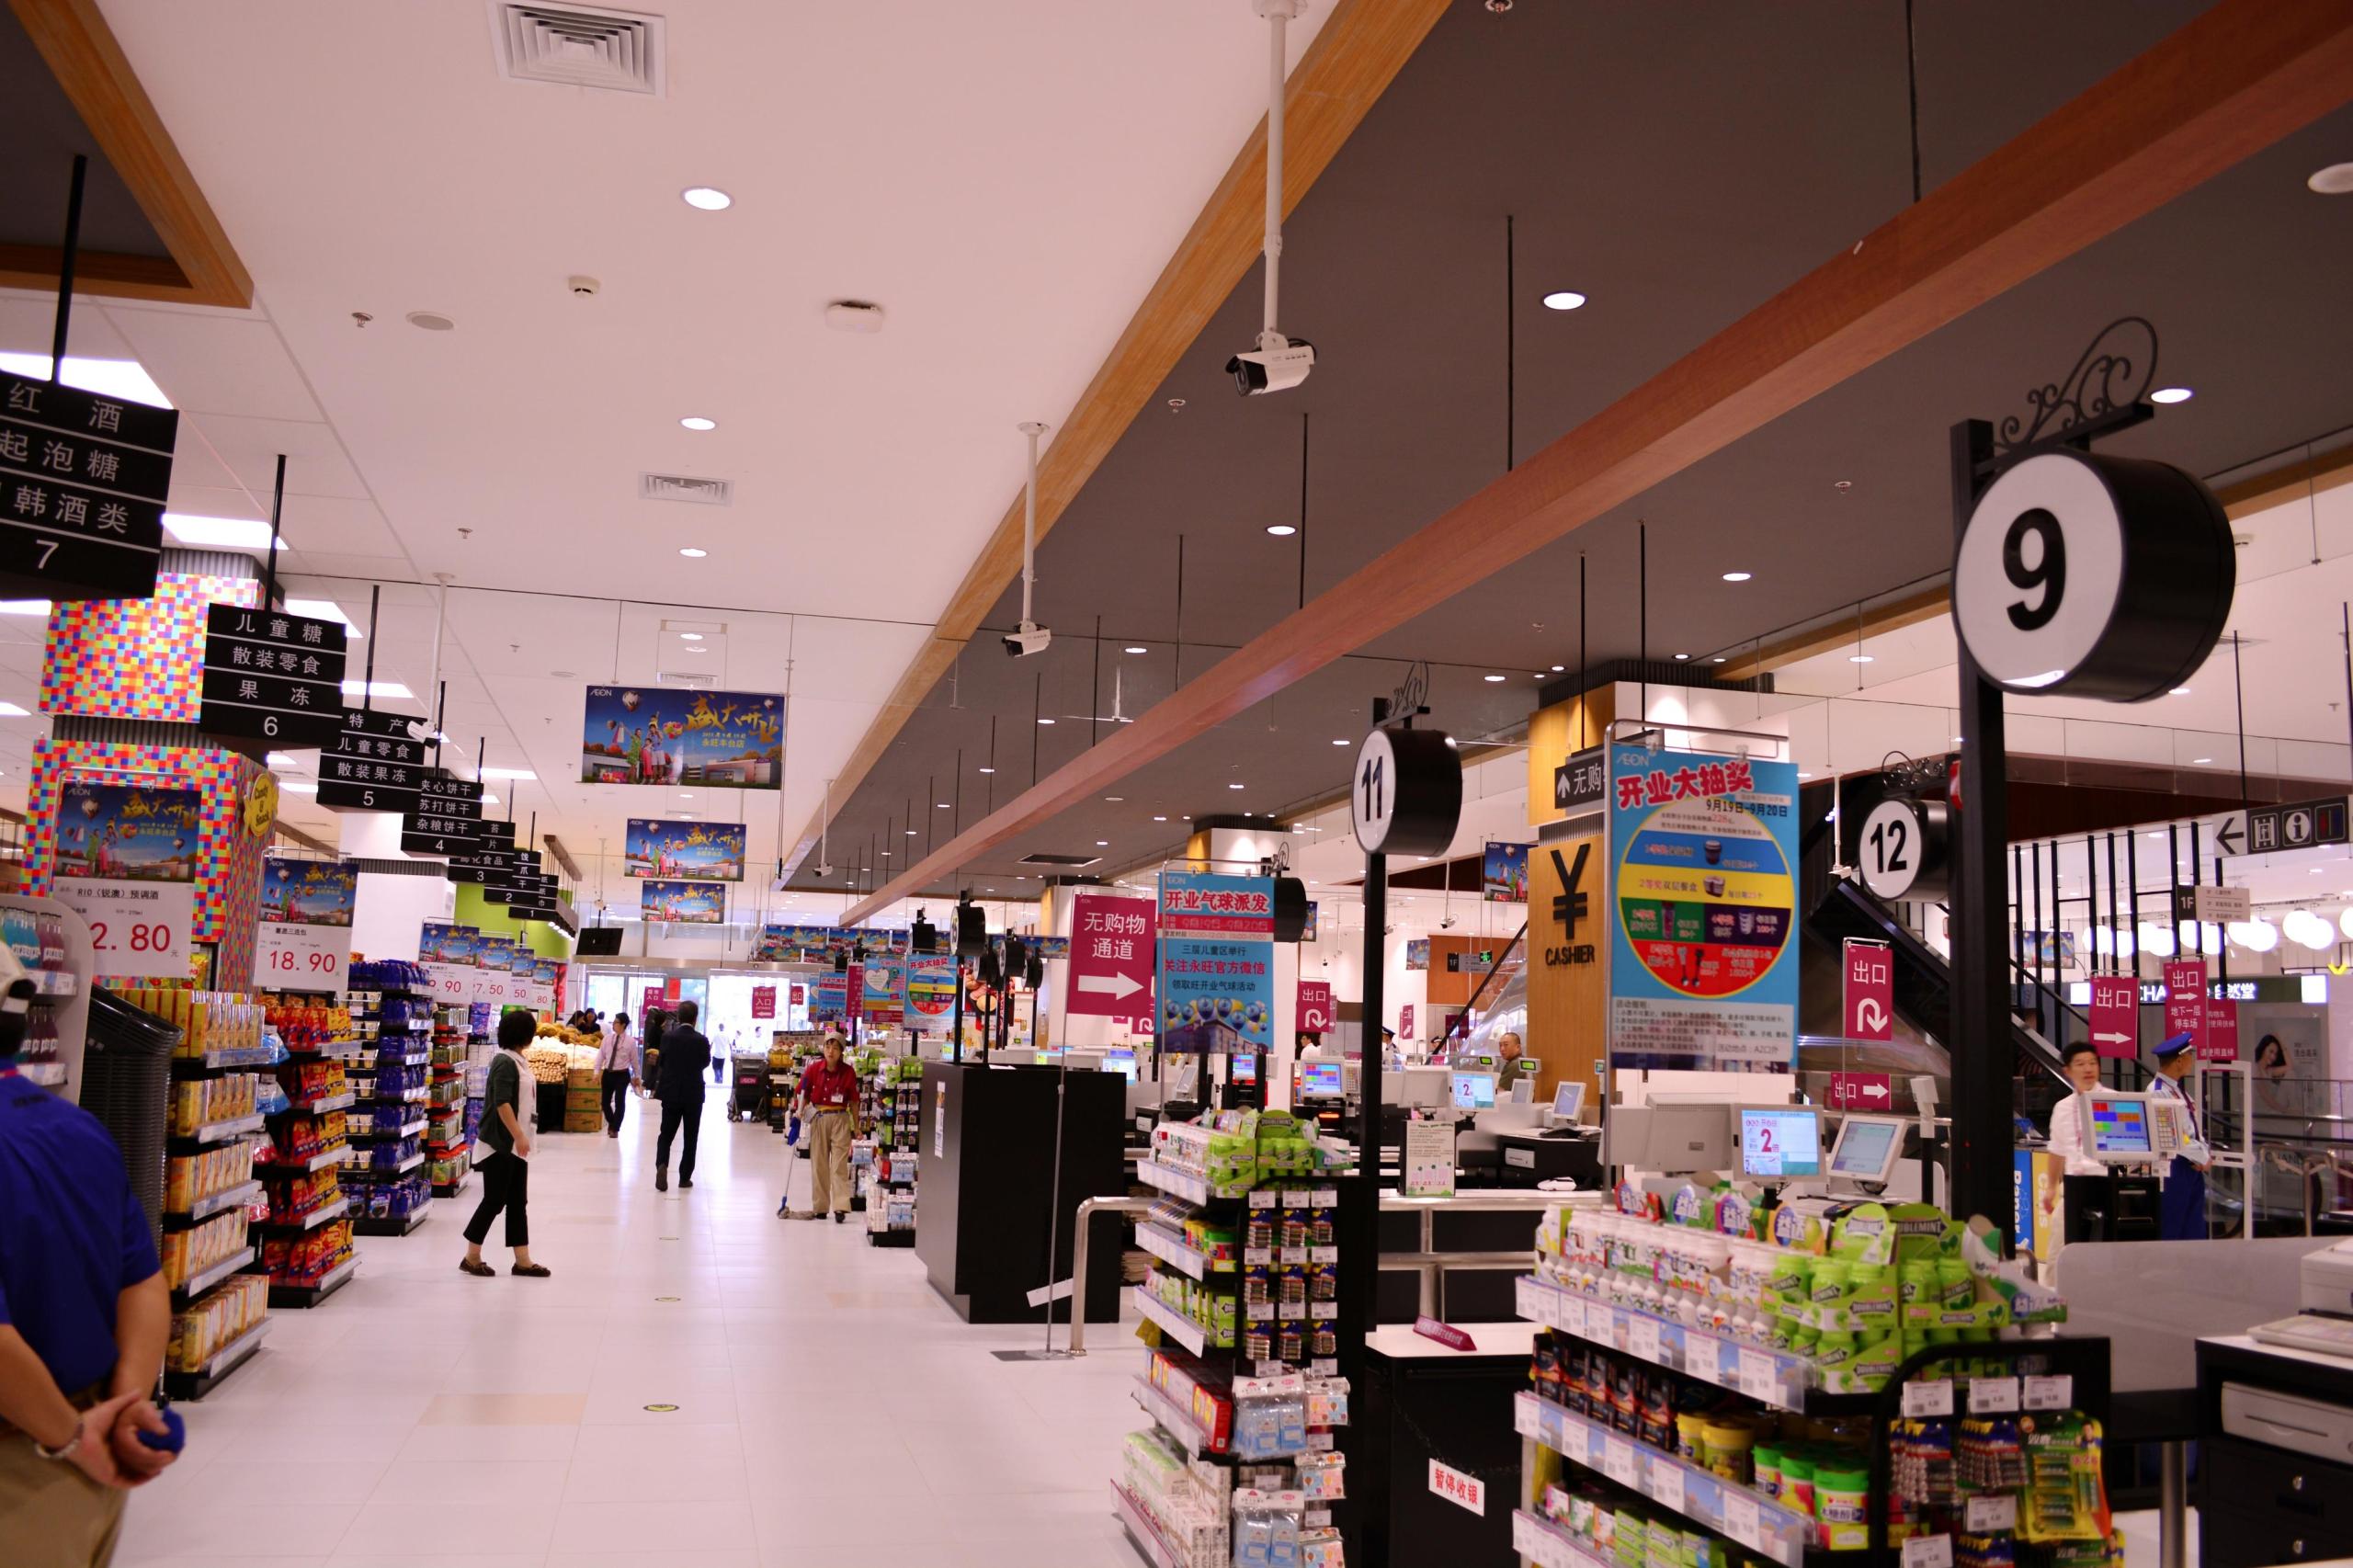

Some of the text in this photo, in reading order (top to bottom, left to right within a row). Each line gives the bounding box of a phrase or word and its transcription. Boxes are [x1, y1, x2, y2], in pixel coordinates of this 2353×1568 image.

[0, 429, 119, 482] 起泡糖
[0, 482, 129, 534] 韩酒类
[35, 539, 60, 570] 7
[2002, 507, 2066, 631] 9
[235, 613, 323, 643] 儿童糖
[233, 646, 321, 676] 散装零食
[238, 680, 311, 706] 果冻
[264, 716, 278, 736] 6
[348, 713, 404, 733] 特产
[337, 736, 410, 759] 儿童零食
[337, 762, 407, 783] 散装果冻
[1573, 762, 1606, 796] 无购
[421, 779, 472, 797] 夹心饼干
[1361, 756, 1383, 822] 11
[1616, 761, 1755, 811] 开业大抽奖
[362, 790, 375, 807] 5
[419, 799, 470, 815] 苏打饼干
[416, 818, 468, 835] 杂粮饼干
[435, 839, 444, 852] 4
[488, 839, 497, 850] 片
[1870, 819, 1908, 874] 12
[476, 871, 484, 882] 3
[506, 892, 513, 903] 2
[1165, 889, 1269, 914] 开业气球派发
[2180, 896, 2195, 910] 1F
[529, 910, 535, 918] 1
[1084, 912, 1147, 936] 无购物
[1092, 937, 1135, 960] 通道
[1545, 944, 1596, 967] CASHIER
[269, 950, 336, 973] 18.90
[1853, 960, 1886, 985] 出口
[2172, 970, 2200, 989] 出口
[756, 998, 772, 1006] 入口
[1302, 988, 1326, 1003] 出口
[2096, 985, 2132, 1010] 出口
[2170, 1005, 2201, 1017] 地下一层
[2175, 1017, 2199, 1029] 停车场
[1435, 1468, 1478, 1506] 暂停收银
